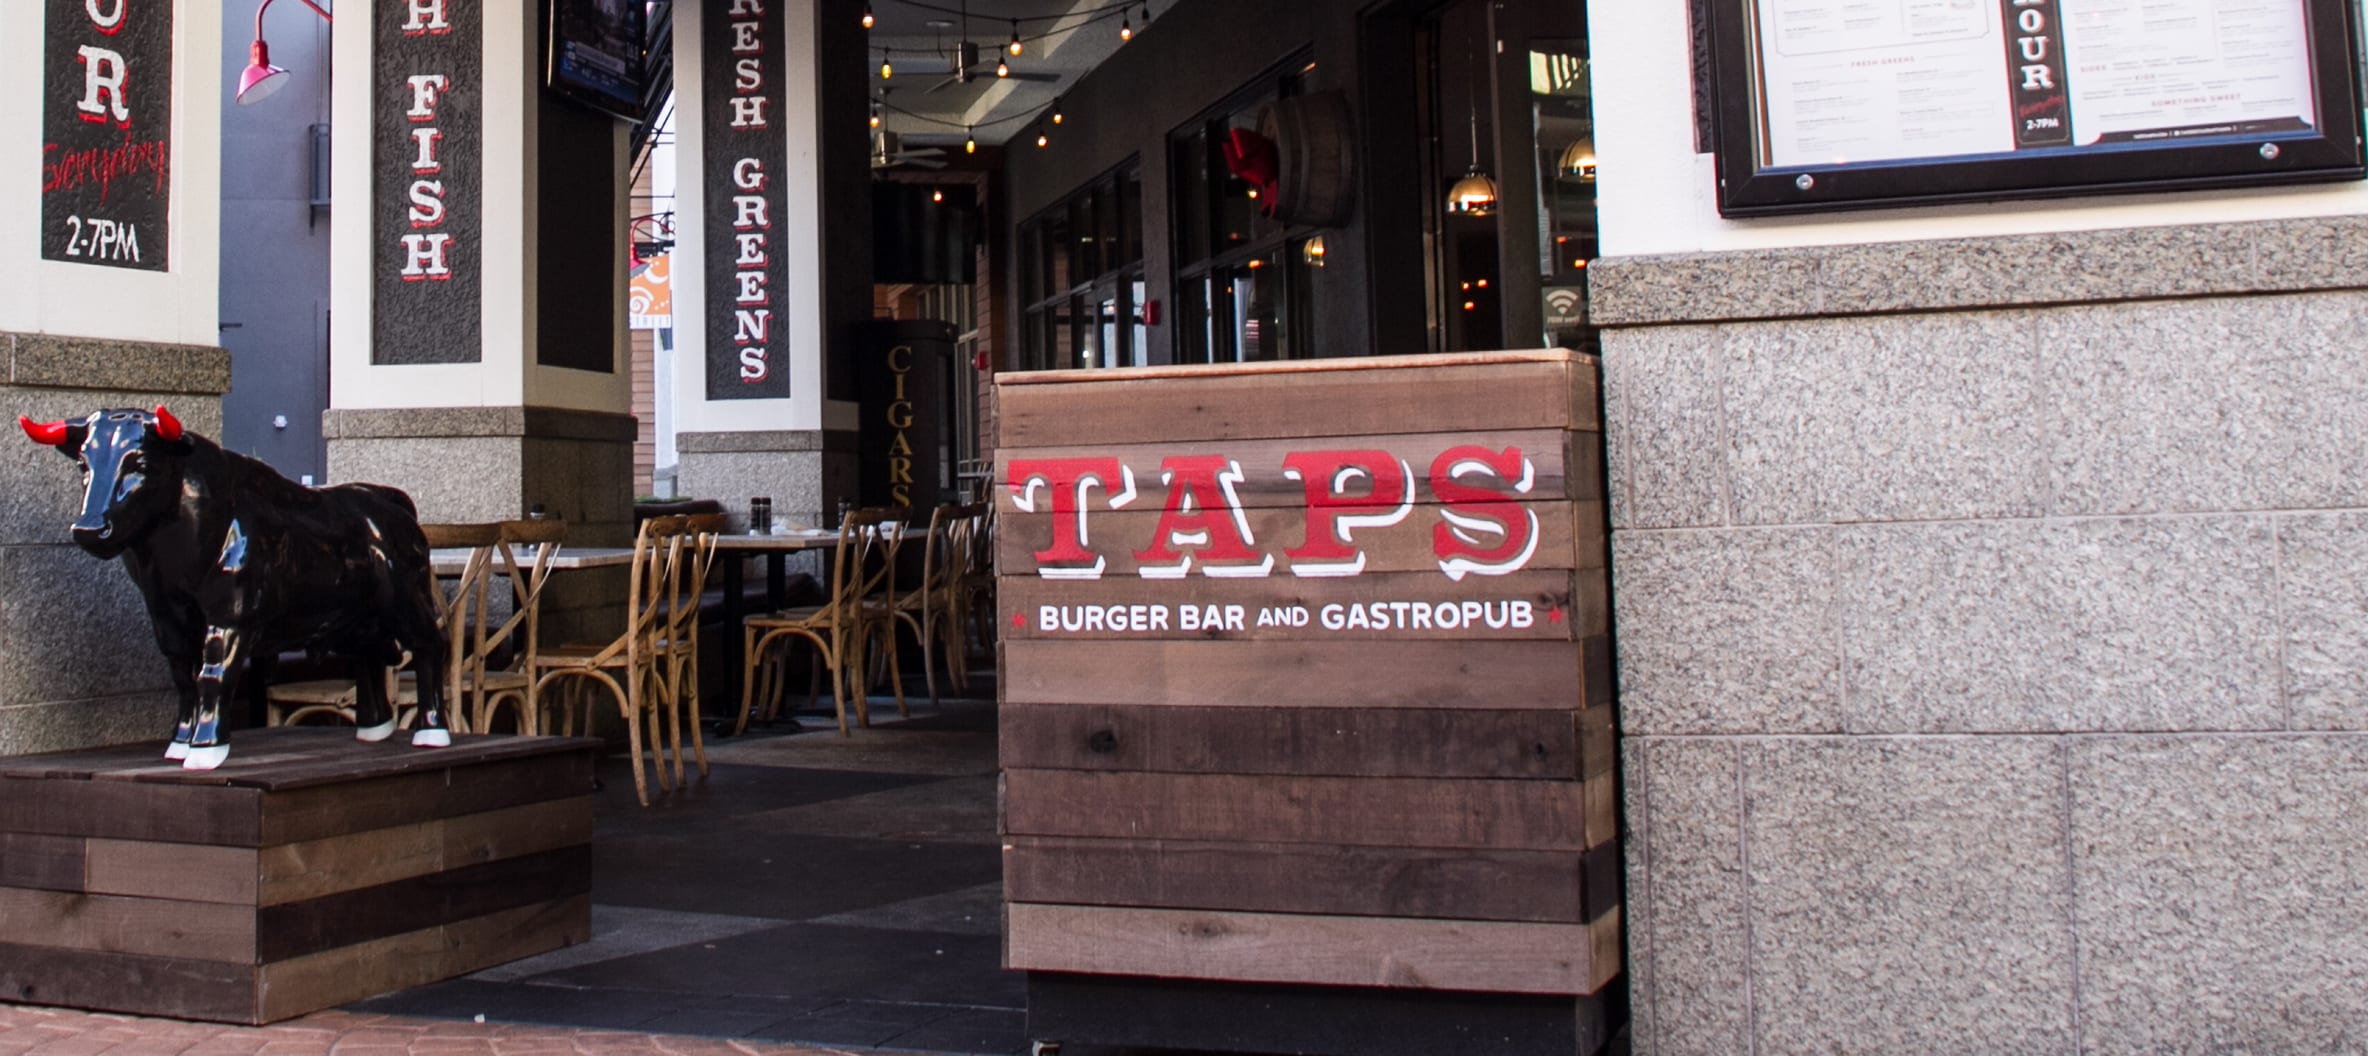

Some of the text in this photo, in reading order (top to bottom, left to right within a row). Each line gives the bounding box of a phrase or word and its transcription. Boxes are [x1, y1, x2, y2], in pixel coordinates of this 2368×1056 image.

[2012, 0, 2055, 91] OUR
[42, 131, 165, 205] Everyday
[2026, 117, 2060, 130] 2-7PM
[401, 74, 453, 282] FISH
[66, 214, 140, 263] 2-7PM
[732, 157, 773, 382] GREENS
[887, 346, 914, 508] CIGARS
[1006, 444, 1540, 582] TAPS
[1039, 600, 1534, 632] BURGER BAR AND GASTROPUB
